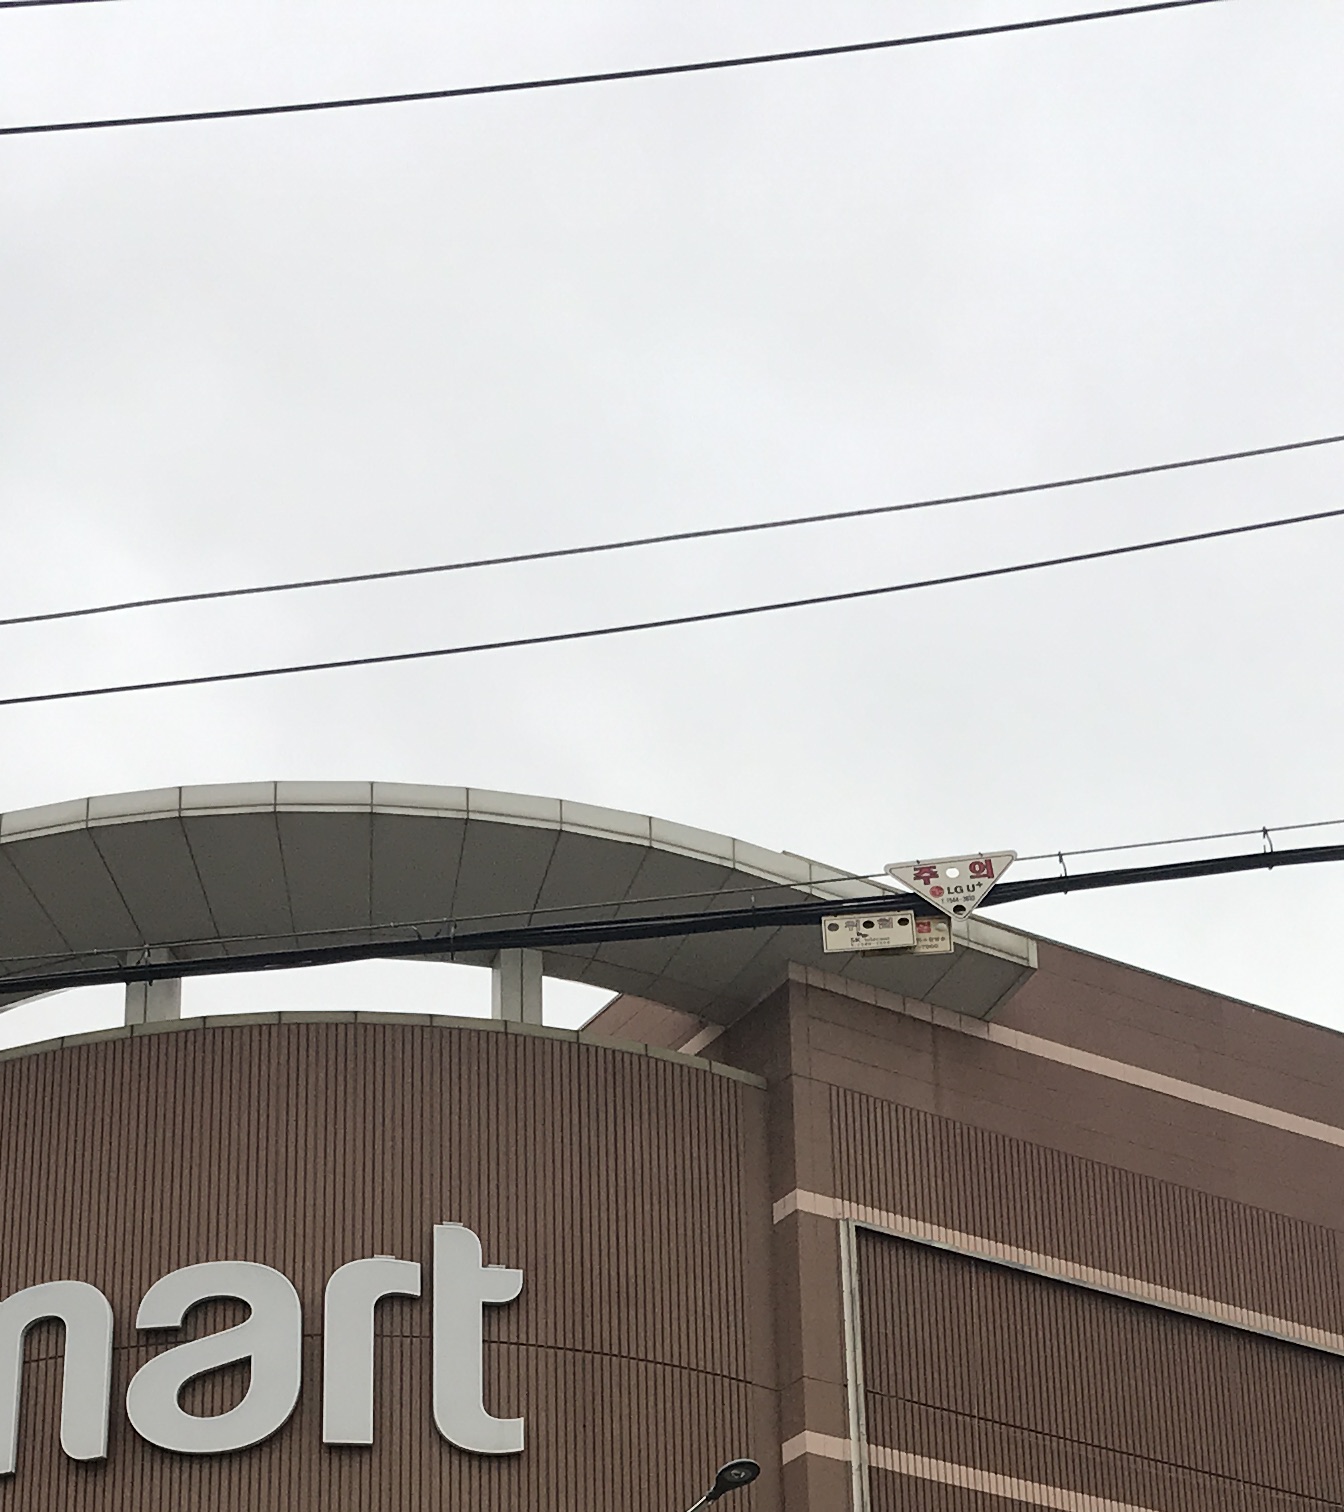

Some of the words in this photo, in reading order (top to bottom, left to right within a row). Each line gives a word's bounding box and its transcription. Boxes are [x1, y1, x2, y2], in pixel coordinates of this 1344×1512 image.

[913, 865, 940, 886] 주
[968, 858, 995, 880] 의
[946, 885, 964, 895] LG
[966, 881, 984, 893] U+
